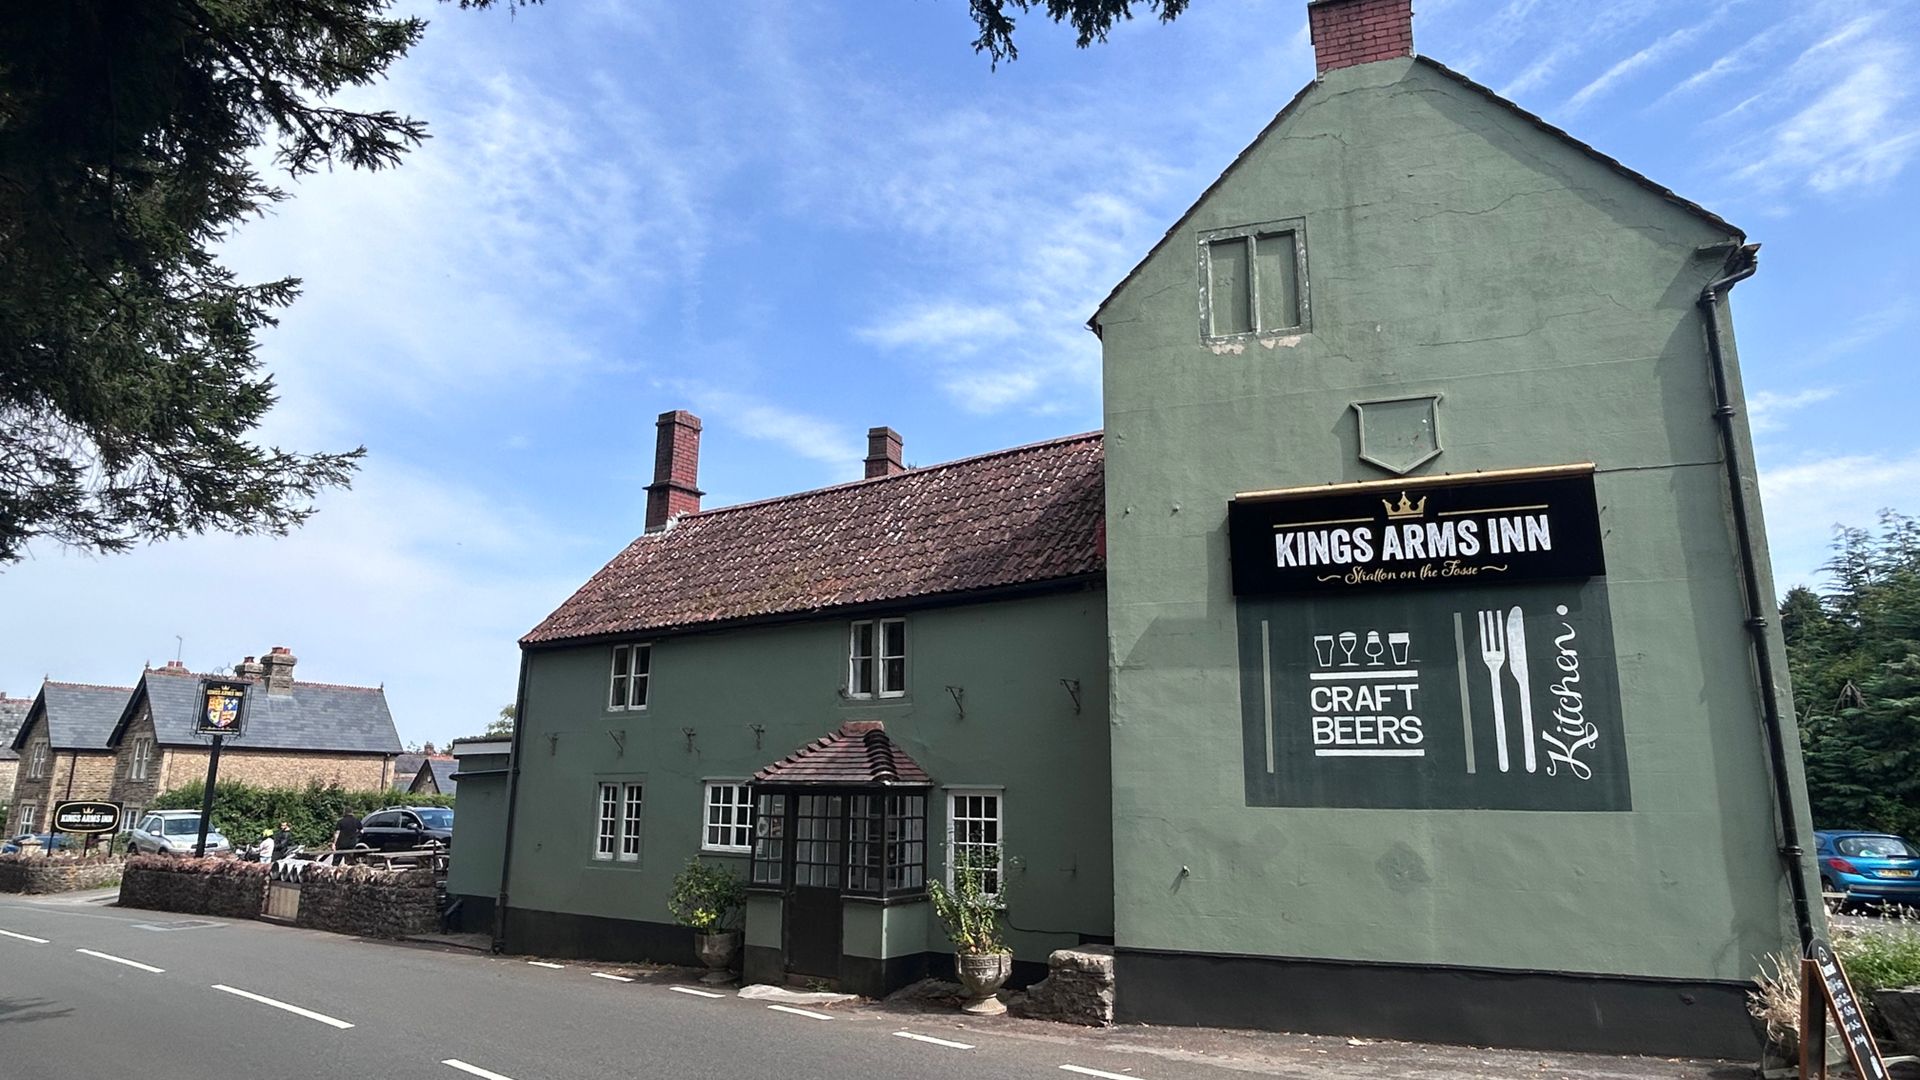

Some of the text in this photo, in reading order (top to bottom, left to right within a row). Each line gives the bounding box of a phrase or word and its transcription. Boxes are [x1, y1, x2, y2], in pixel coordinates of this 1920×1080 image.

[1275, 514, 1552, 568] KINGS ARMS INN
[1344, 559, 1479, 585] Stratton on the Fosse
[1310, 684, 1419, 712] CRAFT
[1312, 715, 1424, 745] BEERS
[60, 814, 114, 823] KINGS ARMS INN
